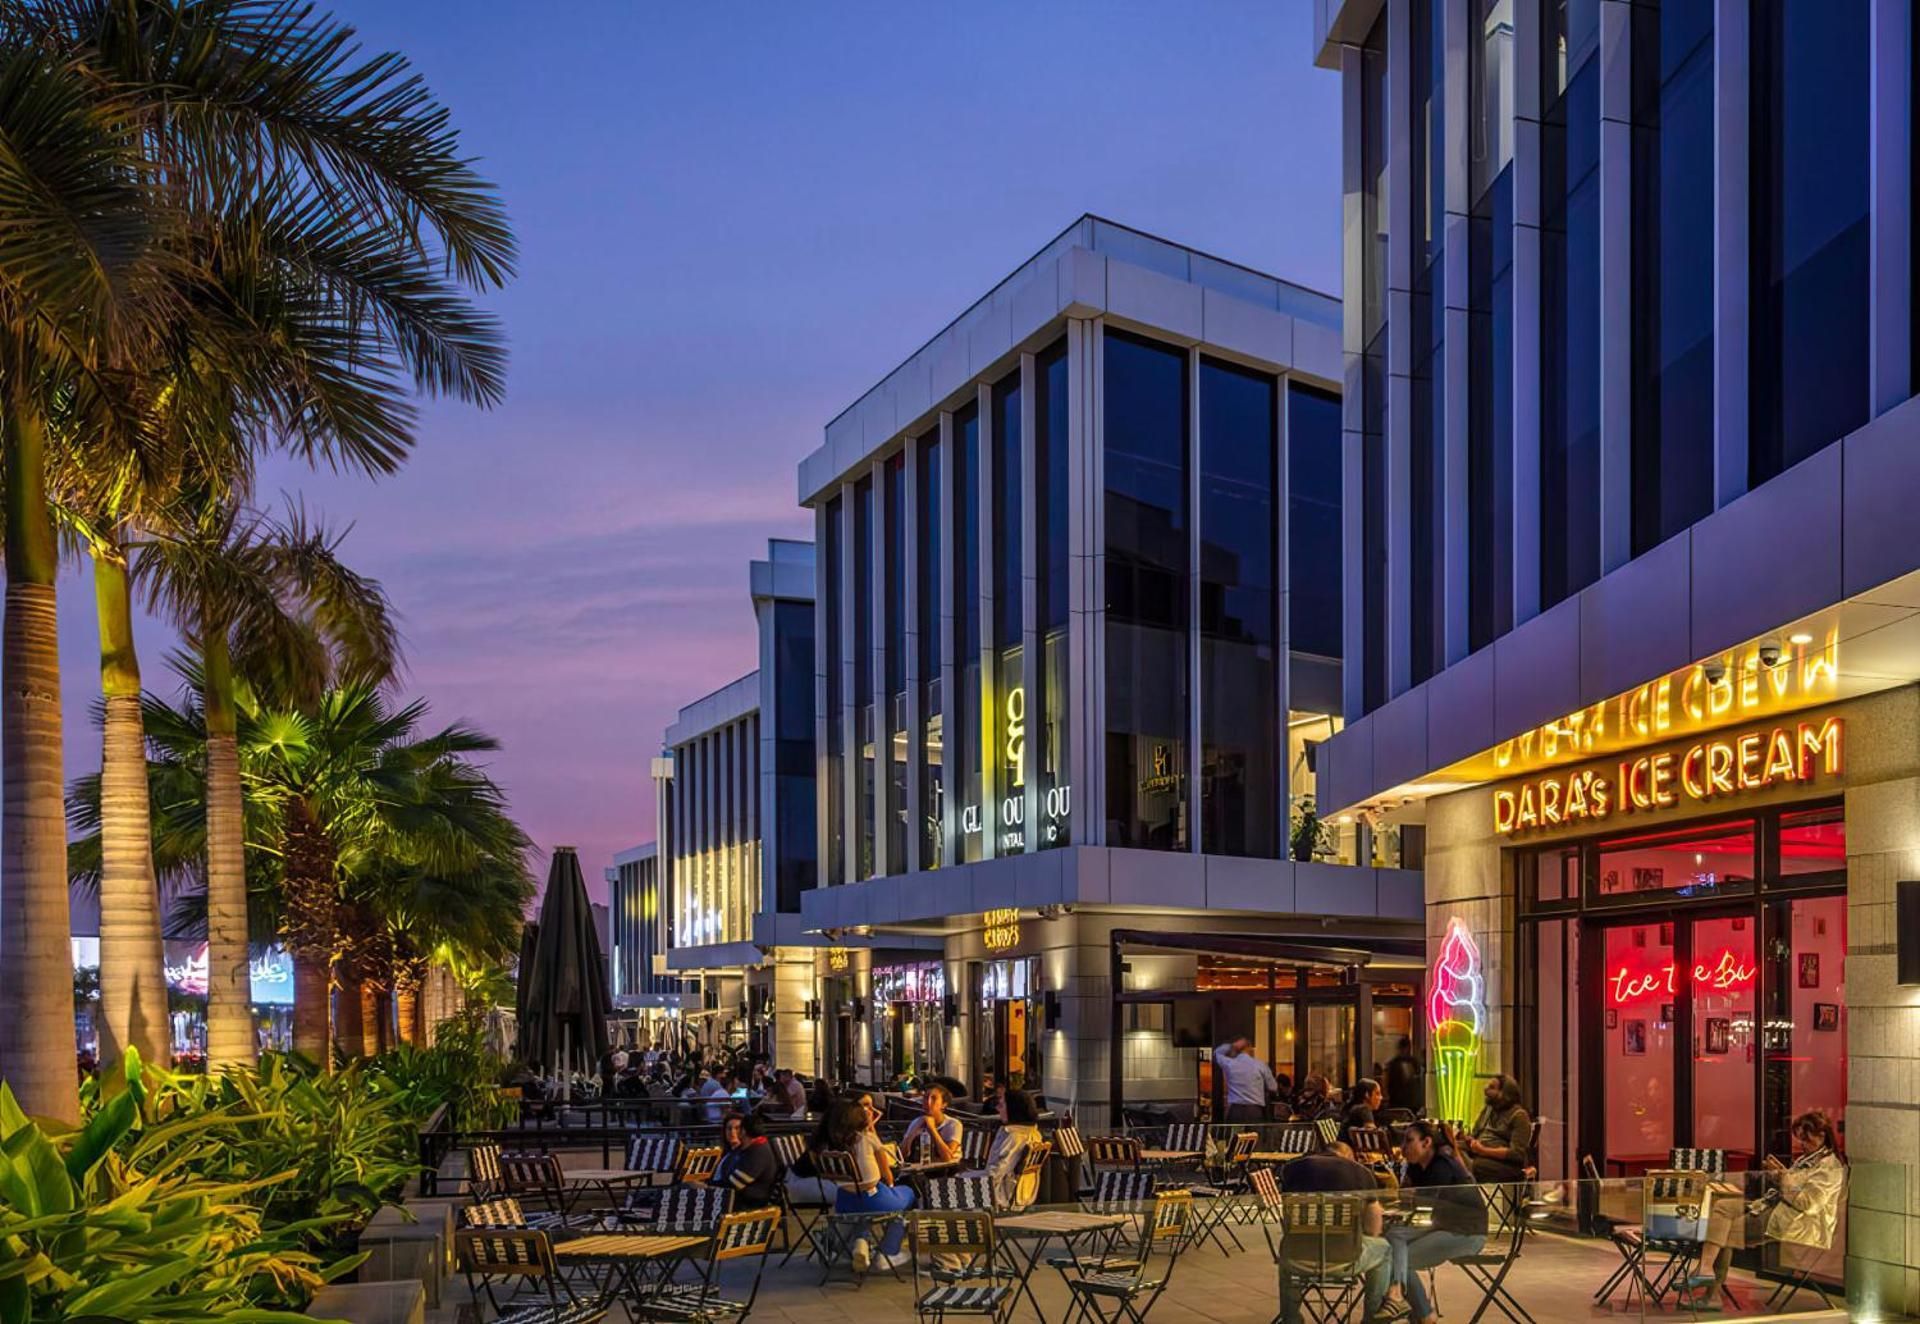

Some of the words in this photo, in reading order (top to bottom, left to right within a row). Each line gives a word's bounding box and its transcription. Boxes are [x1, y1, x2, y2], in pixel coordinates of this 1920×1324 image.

[1619, 753, 1674, 811] ICE
[1682, 717, 1845, 799] CREAM
[1714, 951, 1756, 988] Ba
